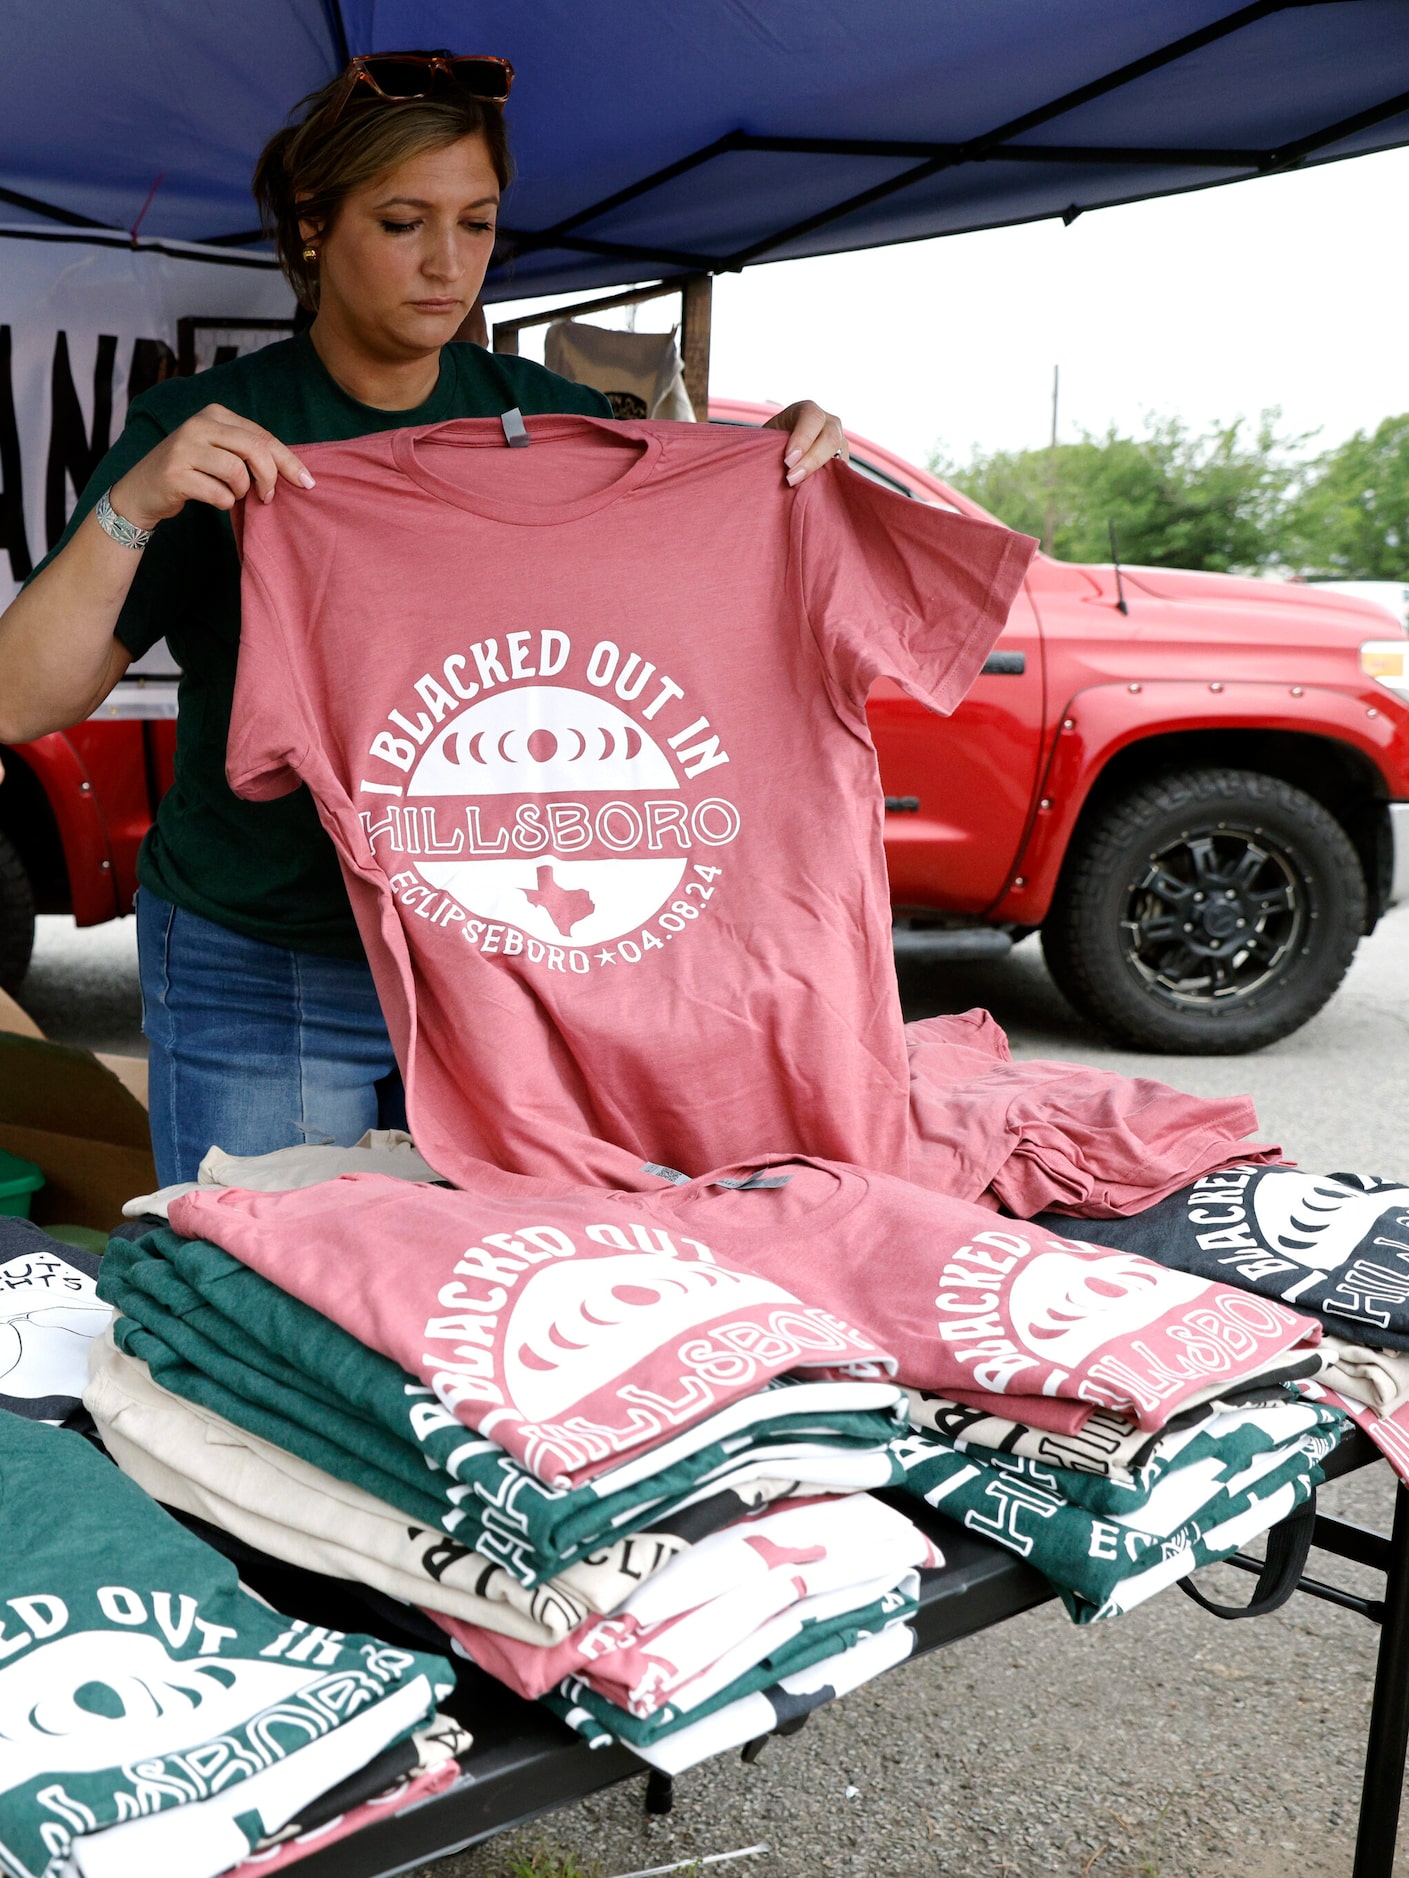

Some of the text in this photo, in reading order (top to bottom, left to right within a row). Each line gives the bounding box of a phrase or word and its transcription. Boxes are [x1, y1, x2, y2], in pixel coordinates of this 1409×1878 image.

[358, 629, 730, 798] I BLACKED OUT IN
[358, 797, 741, 857] HILLSBORO
[388, 863, 724, 975] ECLIPSEBORO 04.08.24
[421, 1225, 577, 1418] BLACKED
[584, 1223, 719, 1266] OUT
[934, 1230, 1033, 1395] BLACKED
[96, 1585, 238, 1656] OUT
